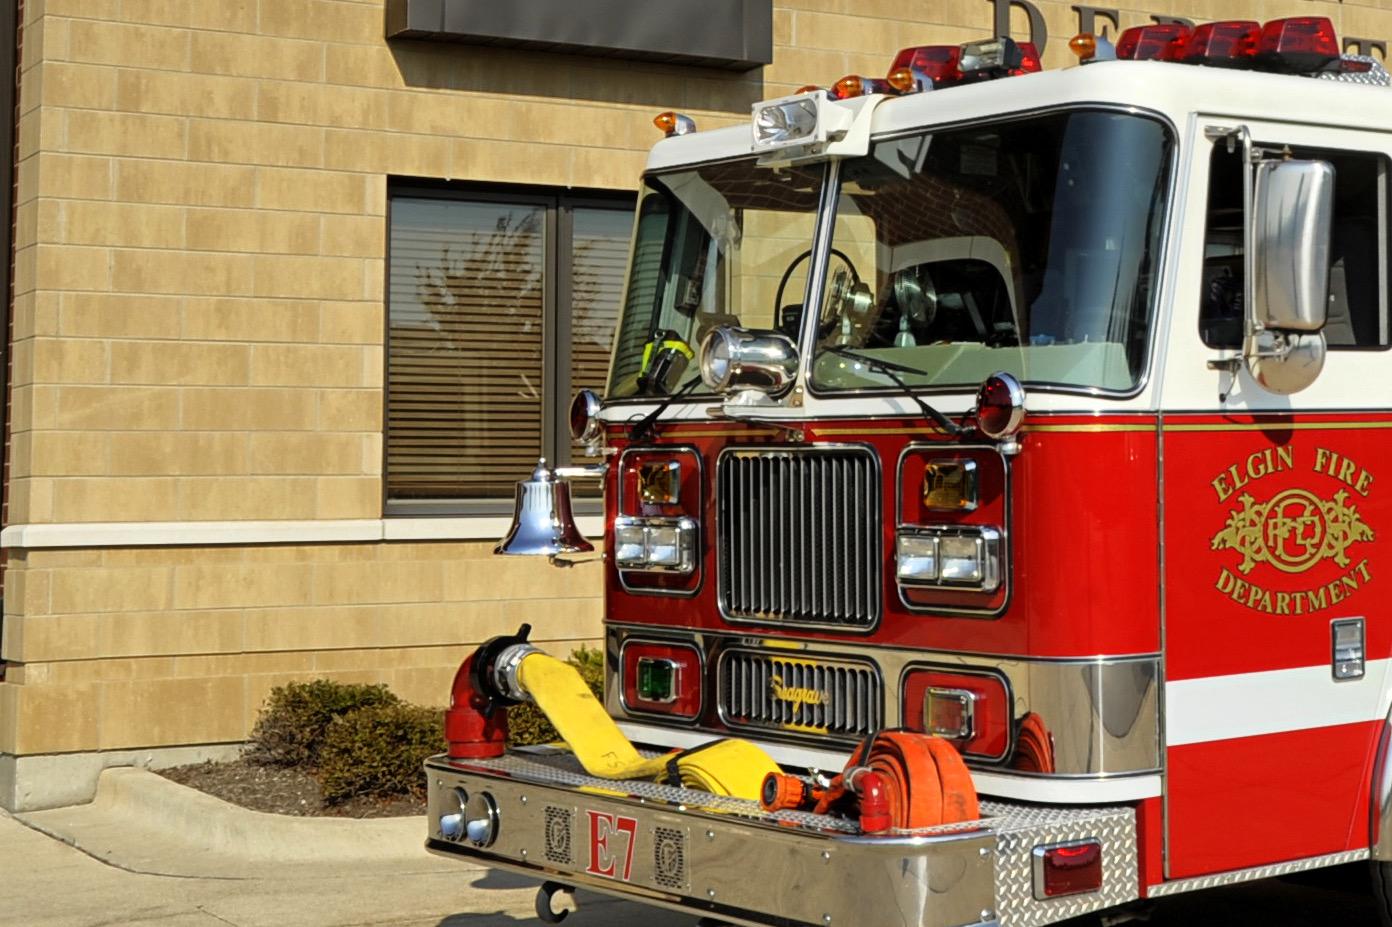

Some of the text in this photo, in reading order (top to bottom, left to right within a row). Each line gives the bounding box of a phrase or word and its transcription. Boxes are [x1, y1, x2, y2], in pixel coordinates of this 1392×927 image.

[1211, 445, 1374, 503] ELGIN FIRE
[1215, 559, 1373, 615] DEPARTMENT
[584, 809, 638, 882] E7
